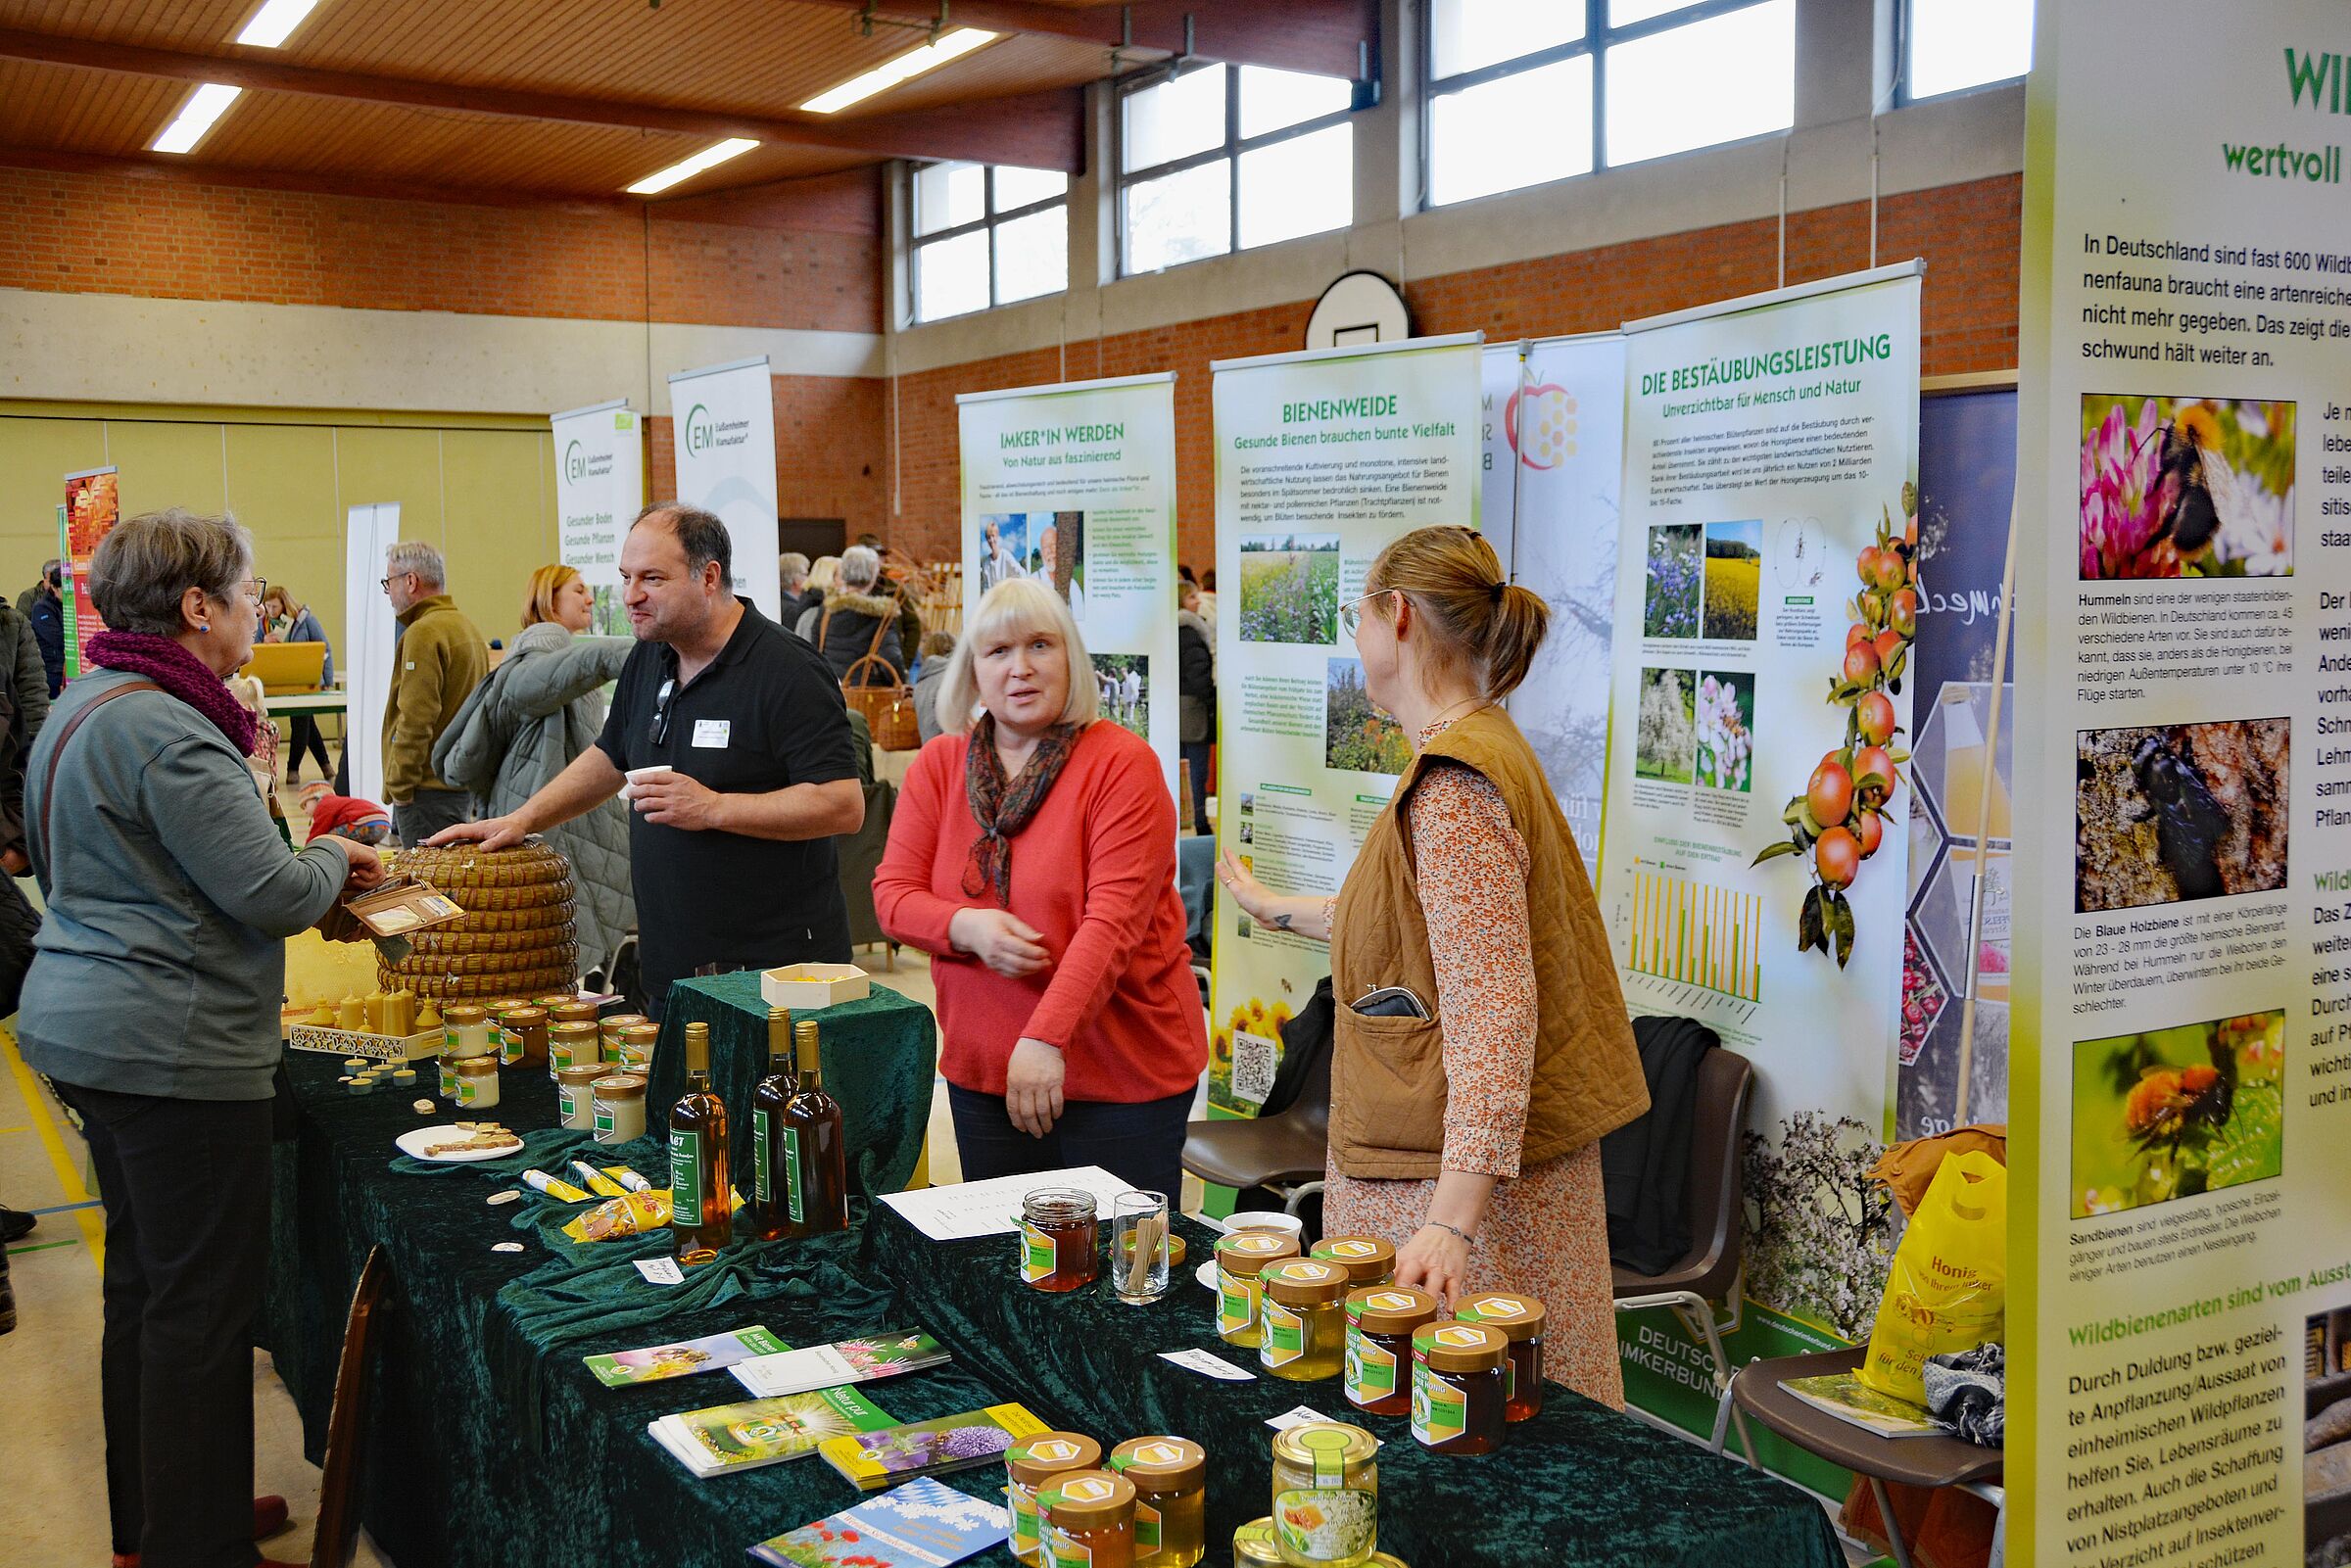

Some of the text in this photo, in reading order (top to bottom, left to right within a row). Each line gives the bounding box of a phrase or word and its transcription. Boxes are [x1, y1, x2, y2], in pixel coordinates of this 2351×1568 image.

[2222, 142, 2340, 183] wertvoll
[2085, 234, 2099, 253] In
[2107, 235, 2209, 262] Deutschland
[2215, 245, 2246, 265] sind
[2251, 248, 2279, 268] fast
[2284, 253, 2310, 270] 600
[2084, 271, 2162, 293] nenfauna
[2168, 274, 2229, 298] braucht
[2233, 283, 2264, 301] eine
[2083, 304, 2351, 341] nicht mehr gegeben. Das zeigt die
[2083, 339, 2274, 366] schwund hält weiter an.
[1643, 334, 1891, 395] DIE BESTÄUBUNGSLEISTUNG
[1283, 395, 1397, 423] BIENENWEIDE
[1663, 378, 1861, 417] Unverzichtbar für Mensch und Natur
[2324, 402, 2339, 420] Je
[695, 424, 713, 449] EM
[1066, 423, 1124, 443] WERDEN
[1234, 422, 1455, 449] Gesunde Bienen brauchen bunte Vielfalt
[571, 458, 586, 479] EM
[1003, 450, 1121, 467] Von Natur aus faszinierend
[1240, 465, 1251, 474] Die
[1397, 456, 1428, 465] intensive
[566, 513, 612, 527] Gesunder Boden
[564, 533, 615, 546] Gesunde Pflanzen
[565, 553, 614, 565] Gesunder Mensch
[2079, 591, 2292, 606] Hummeln sind eine der wenigen staatenbilden-
[2321, 593, 2345, 609] Der
[2079, 607, 2292, 626] den Wildbienen. In Deutschland kommen ca. 45
[2079, 626, 2292, 645] verschiedene Arten vor. Sie sind auch dafür be-
[2078, 688, 2145, 703] Flüge starten.
[2314, 870, 2351, 892] Wild
[2075, 903, 2287, 940] Die Blaue Holzbiene ist mit einer Körperlänge
[2314, 907, 2339, 925] Das
[2313, 935, 2351, 955] weite
[2312, 968, 2339, 985] eine
[2311, 1026, 2334, 1046] auf
[2309, 1085, 2335, 1107] und
[1932, 1256, 1977, 1279] Honig
[1930, 1278, 1959, 1292] Ihrem
[2068, 1296, 2223, 1348] Wildbienenarten
[2228, 1281, 2263, 1310] sind
[2268, 1275, 2301, 1299] vom
[1358, 1344, 1377, 1355] HONIG
[1639, 1326, 1741, 1375] DEUTSC
[1905, 1350, 1926, 1362] Sch
[2069, 1323, 2283, 1395] Durch Duldung bzw. geziel-
[1878, 1352, 1918, 1375] für den
[1425, 1381, 1446, 1394] HONIG
[2069, 1354, 2285, 1427] te Anpflanzung/Aussaat von
[830, 1386, 851, 1409] Natur
[848, 1401, 868, 1417] pur
[2068, 1384, 2284, 1459] einheimischen Wildpflanzen
[2068, 1415, 2282, 1491] helfen Sie, Lebensräume zu
[2067, 1444, 2284, 1522] erhalten. Auch die Schaffung
[2066, 1473, 2278, 1553] von Nistplatzangeboten und
[2100, 1506, 2285, 1568] Verzicht auf Insektenver-
[2196, 1540, 2265, 1568] schützen
